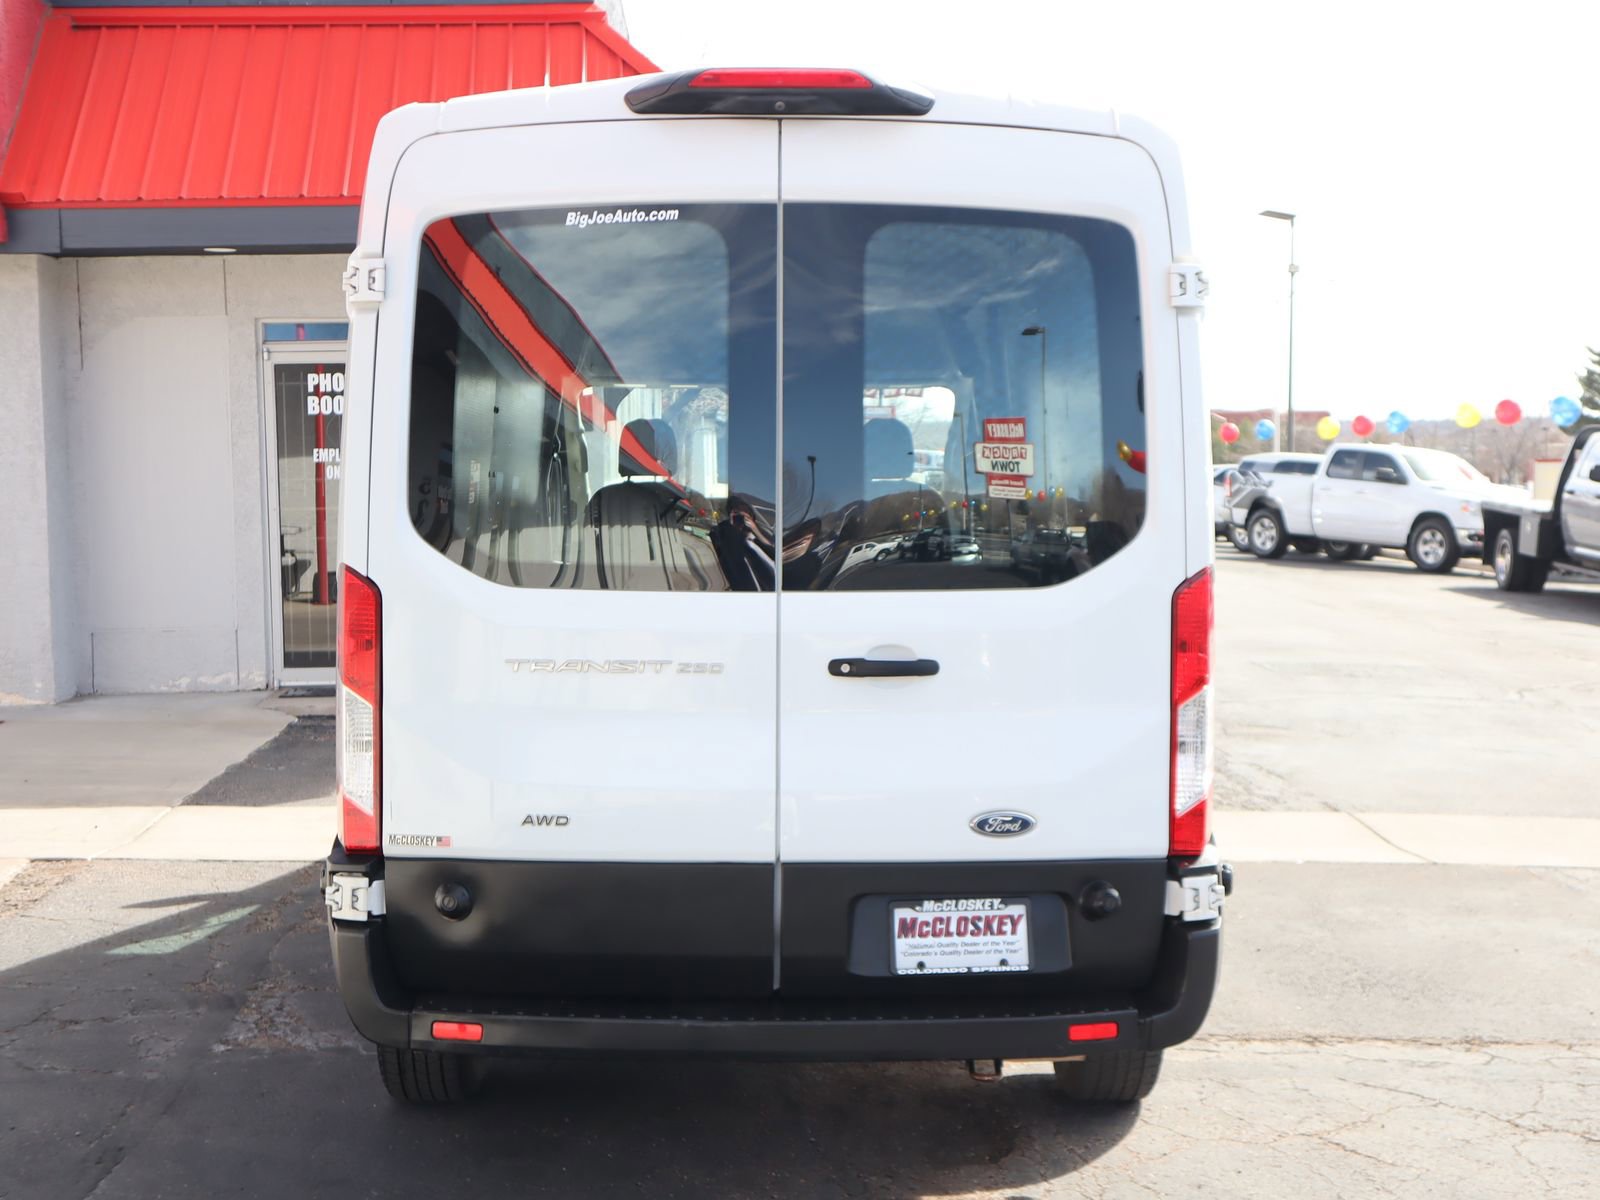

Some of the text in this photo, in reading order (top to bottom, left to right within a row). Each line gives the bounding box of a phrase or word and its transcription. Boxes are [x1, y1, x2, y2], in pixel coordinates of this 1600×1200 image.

[565, 209, 680, 228] BigJoeAuto.com
[504, 658, 725, 675] TRANSIT 250
[521, 814, 571, 827] AWD
[984, 815, 1023, 832] Ford
[388, 834, 435, 847] McCLOSKEY
[923, 898, 1001, 912] McCLOSKEY
[897, 914, 1024, 938] McCLOSKEY
